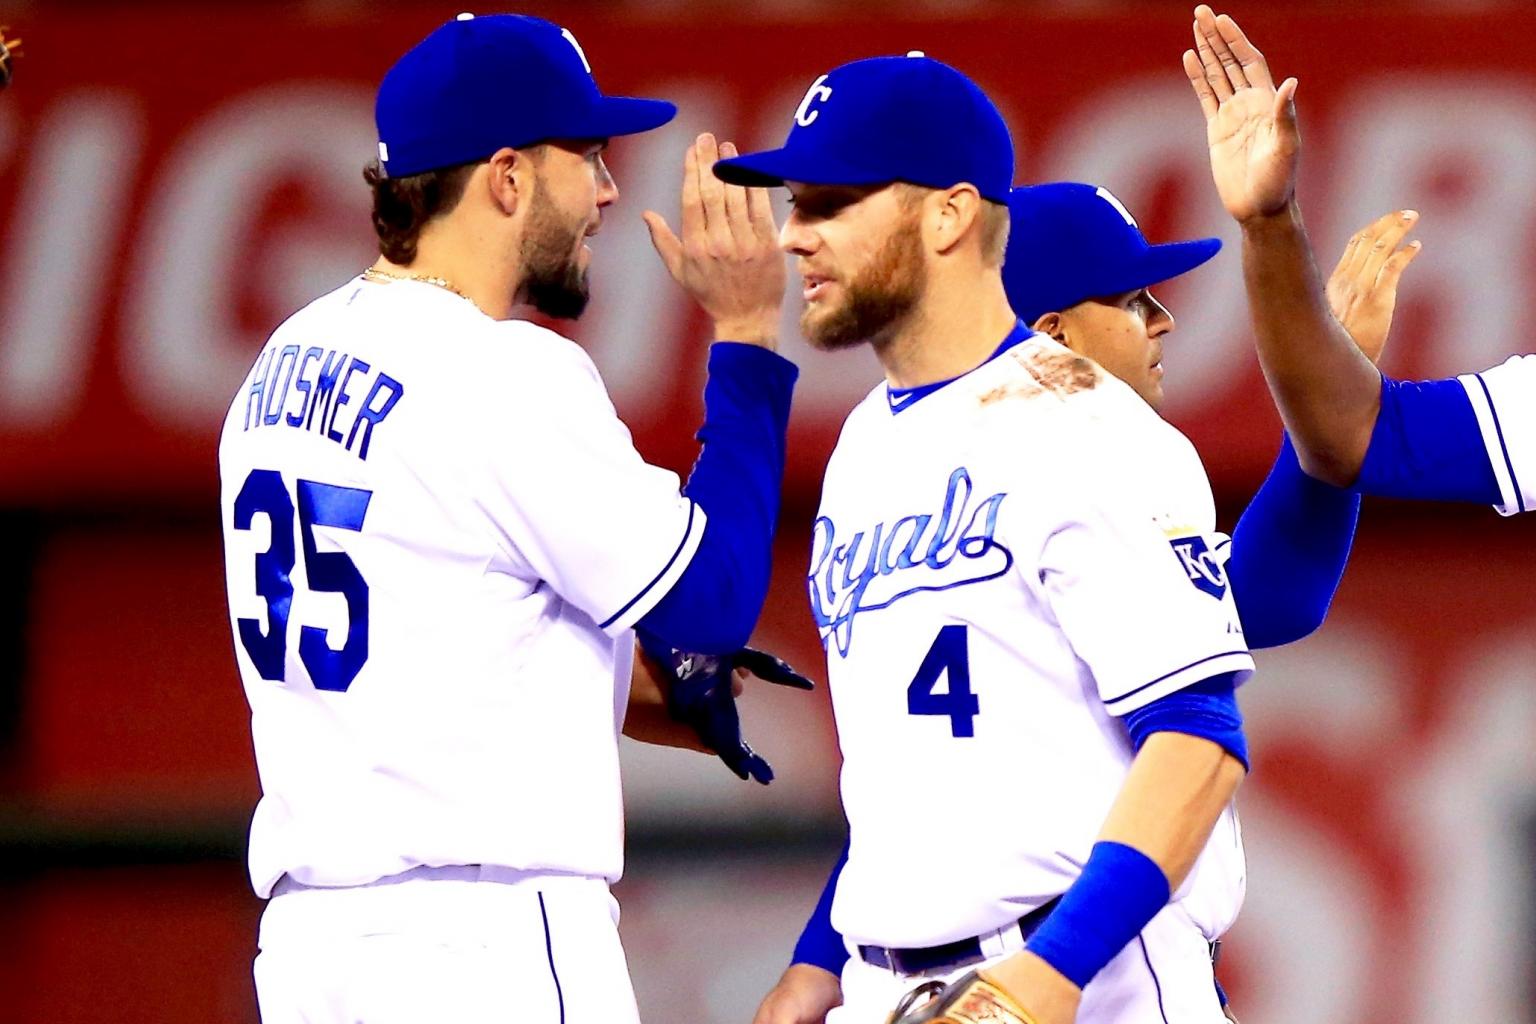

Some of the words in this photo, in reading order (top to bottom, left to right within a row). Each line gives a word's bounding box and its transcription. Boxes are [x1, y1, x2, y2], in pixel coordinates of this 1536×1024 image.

[243, 344, 404, 461] HOSMER
[233, 468, 373, 692] 35
[1174, 543, 1226, 587] KC
[907, 625, 980, 738] 4
